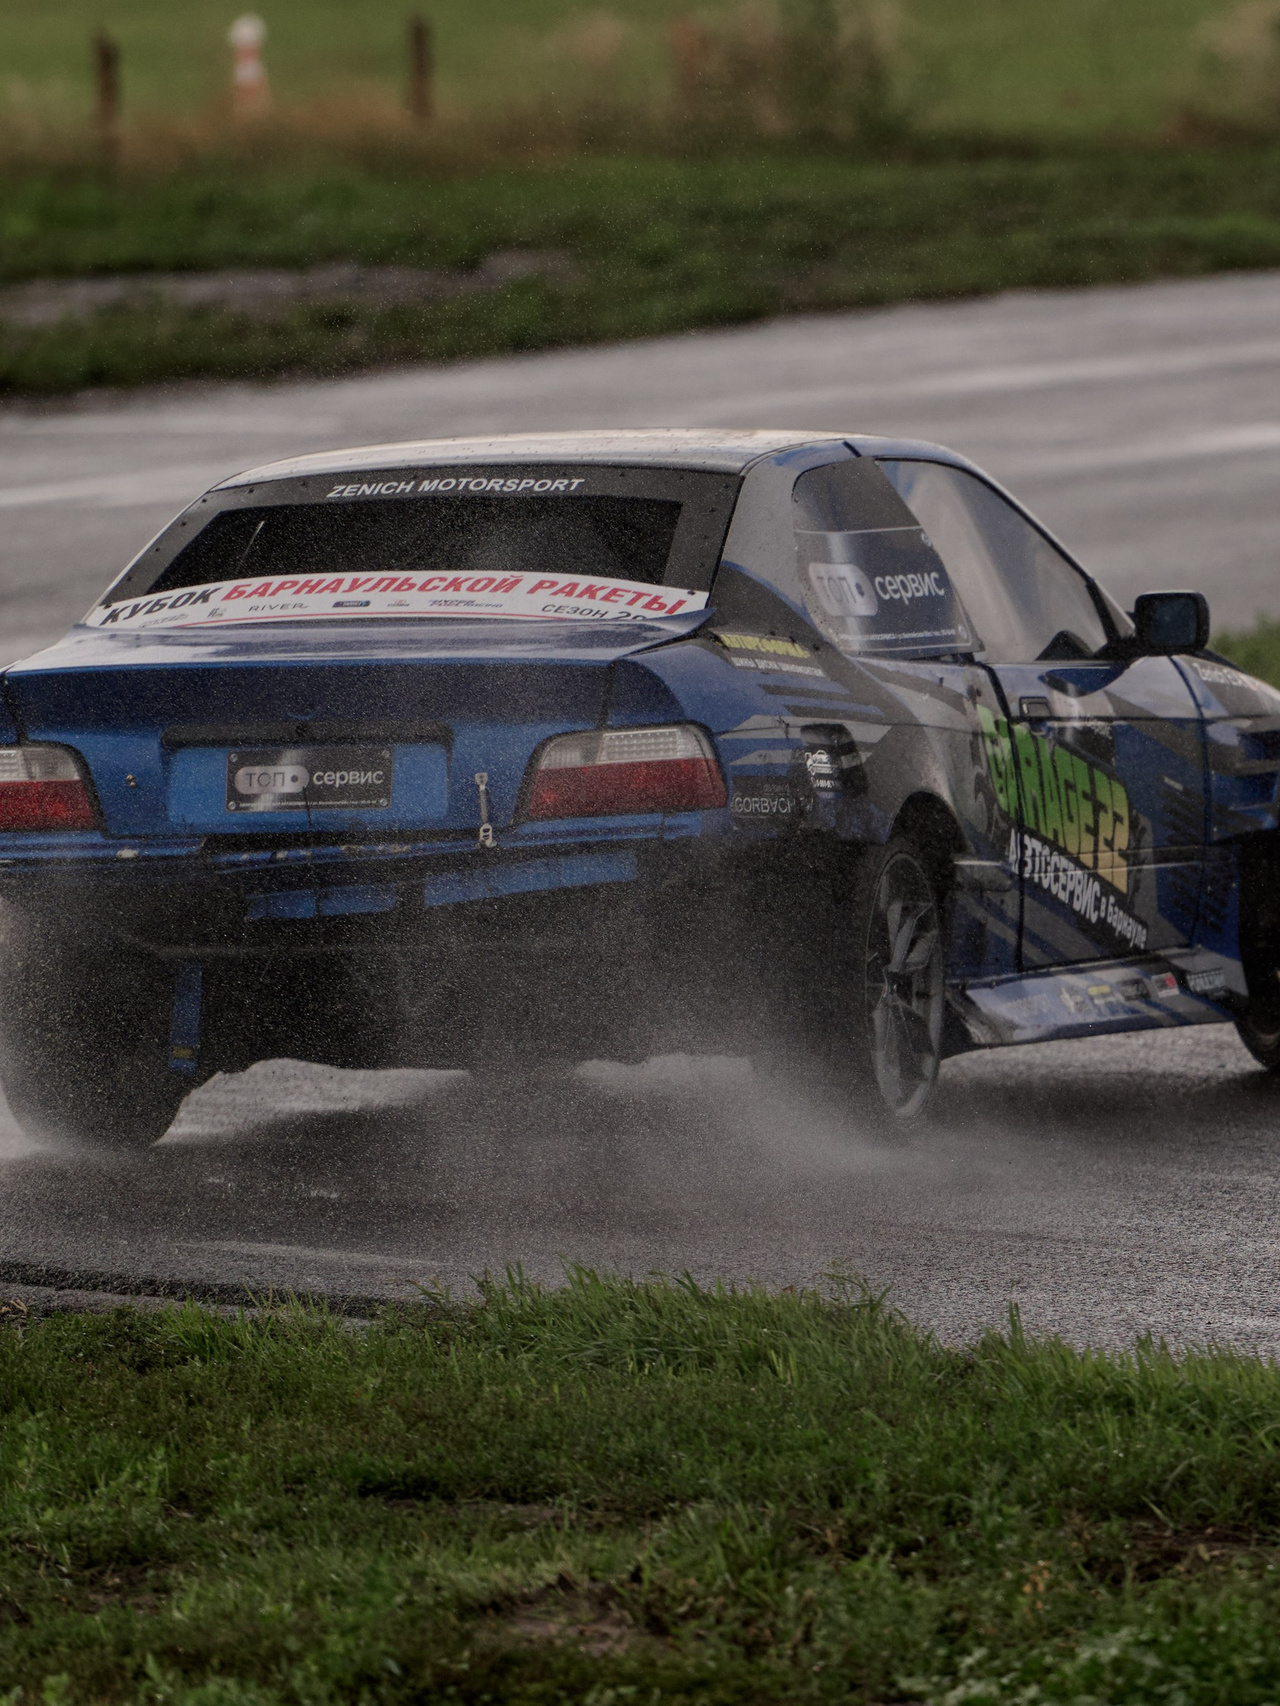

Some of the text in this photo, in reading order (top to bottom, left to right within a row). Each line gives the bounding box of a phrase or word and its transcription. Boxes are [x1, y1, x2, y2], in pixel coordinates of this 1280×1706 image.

[326, 477, 586, 499] ZENICH MOTORSPORT
[873, 570, 946, 606] сервис
[98, 586, 224, 627] КУБОК
[220, 574, 524, 601] БАРНАУЛЬСКОЙ
[526, 579, 688, 615] РАКЕТЫ
[248, 602, 311, 613] RIVER
[541, 603, 609, 619] СЕЗОН
[243, 769, 385, 788] ТОП сервис
